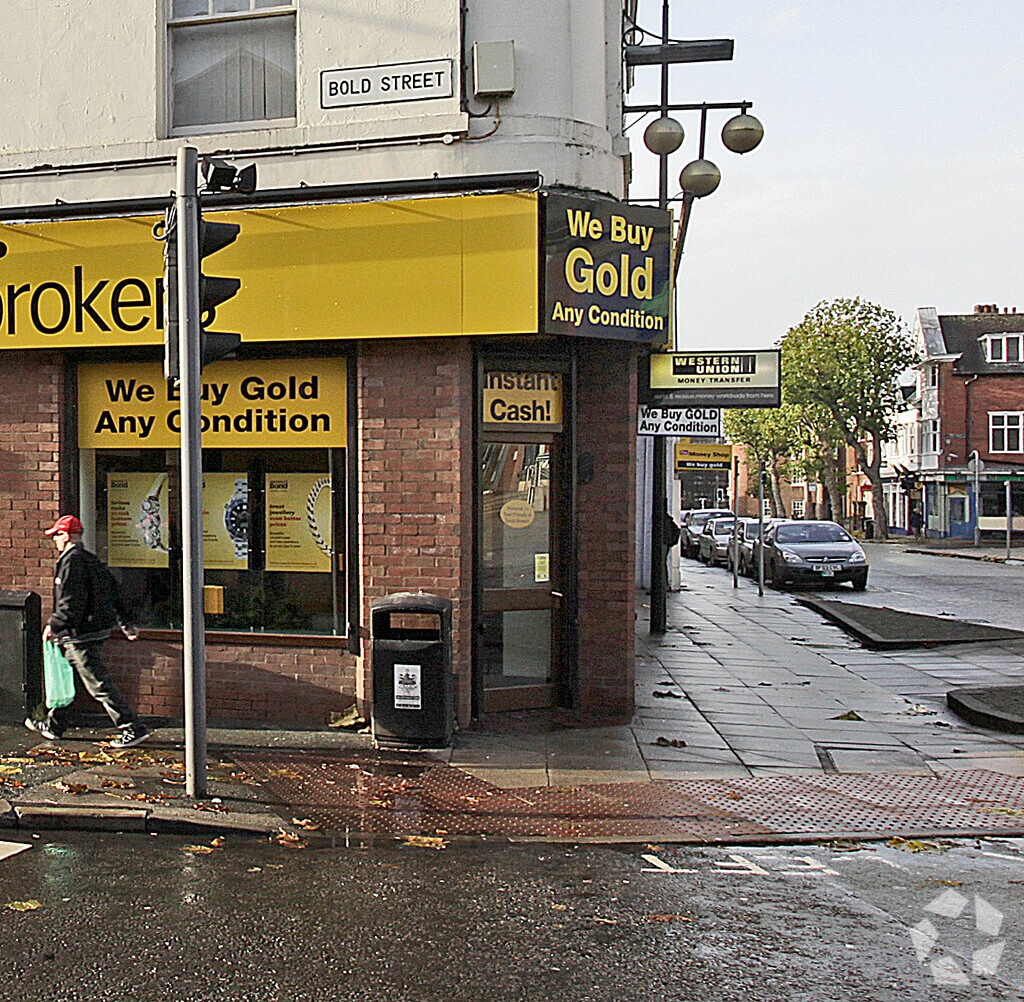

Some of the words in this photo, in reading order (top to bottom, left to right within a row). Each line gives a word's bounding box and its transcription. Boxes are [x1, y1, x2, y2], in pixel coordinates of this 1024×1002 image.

[329, 79, 371, 96] BOLD
[381, 71, 445, 91] STREET
[567, 209, 603, 239] We
[611, 215, 653, 251] Buy
[565, 247, 653, 299] Gold
[552, 301, 584, 326] Any
[588, 305, 664, 330] Condition
[675, 357, 740, 366] WESTERN
[696, 365, 740, 374] UNION
[105, 379, 154, 402] We
[240, 376, 319, 400] Gold
[490, 399, 550, 421] Cash!
[641, 408, 658, 419] We
[661, 408, 682, 421] Buy
[685, 409, 718, 419] GOLD
[95, 411, 155, 438] Any
[640, 420, 661, 433] Any
[664, 421, 717, 432] Condition
